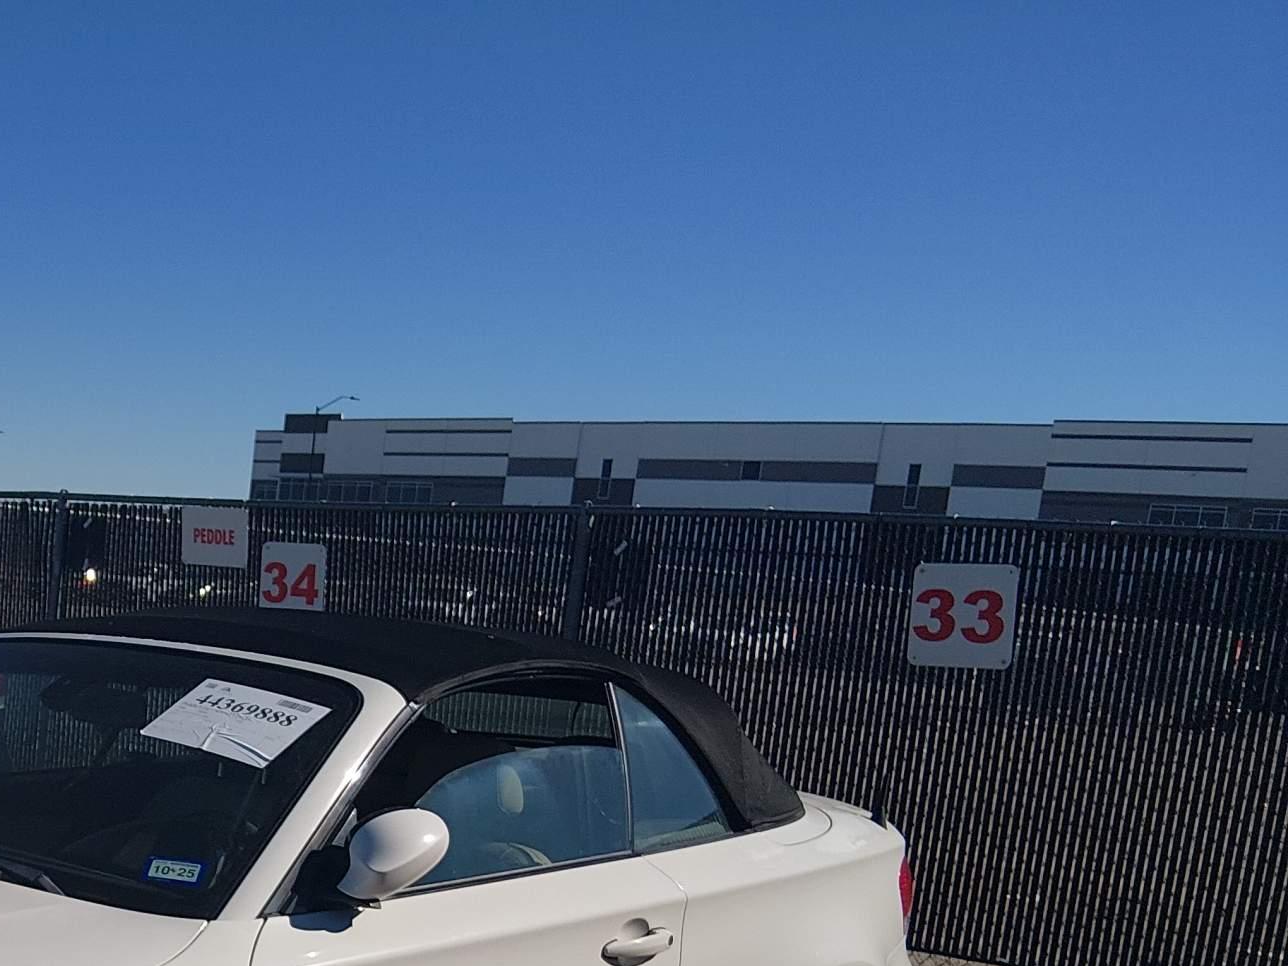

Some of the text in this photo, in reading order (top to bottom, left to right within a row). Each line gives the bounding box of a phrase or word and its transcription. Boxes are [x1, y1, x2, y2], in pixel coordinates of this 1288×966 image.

[193, 527, 235, 546] PEDDLE
[262, 561, 319, 606] 34
[912, 588, 1005, 645] 33
[195, 694, 298, 727] 44369888
